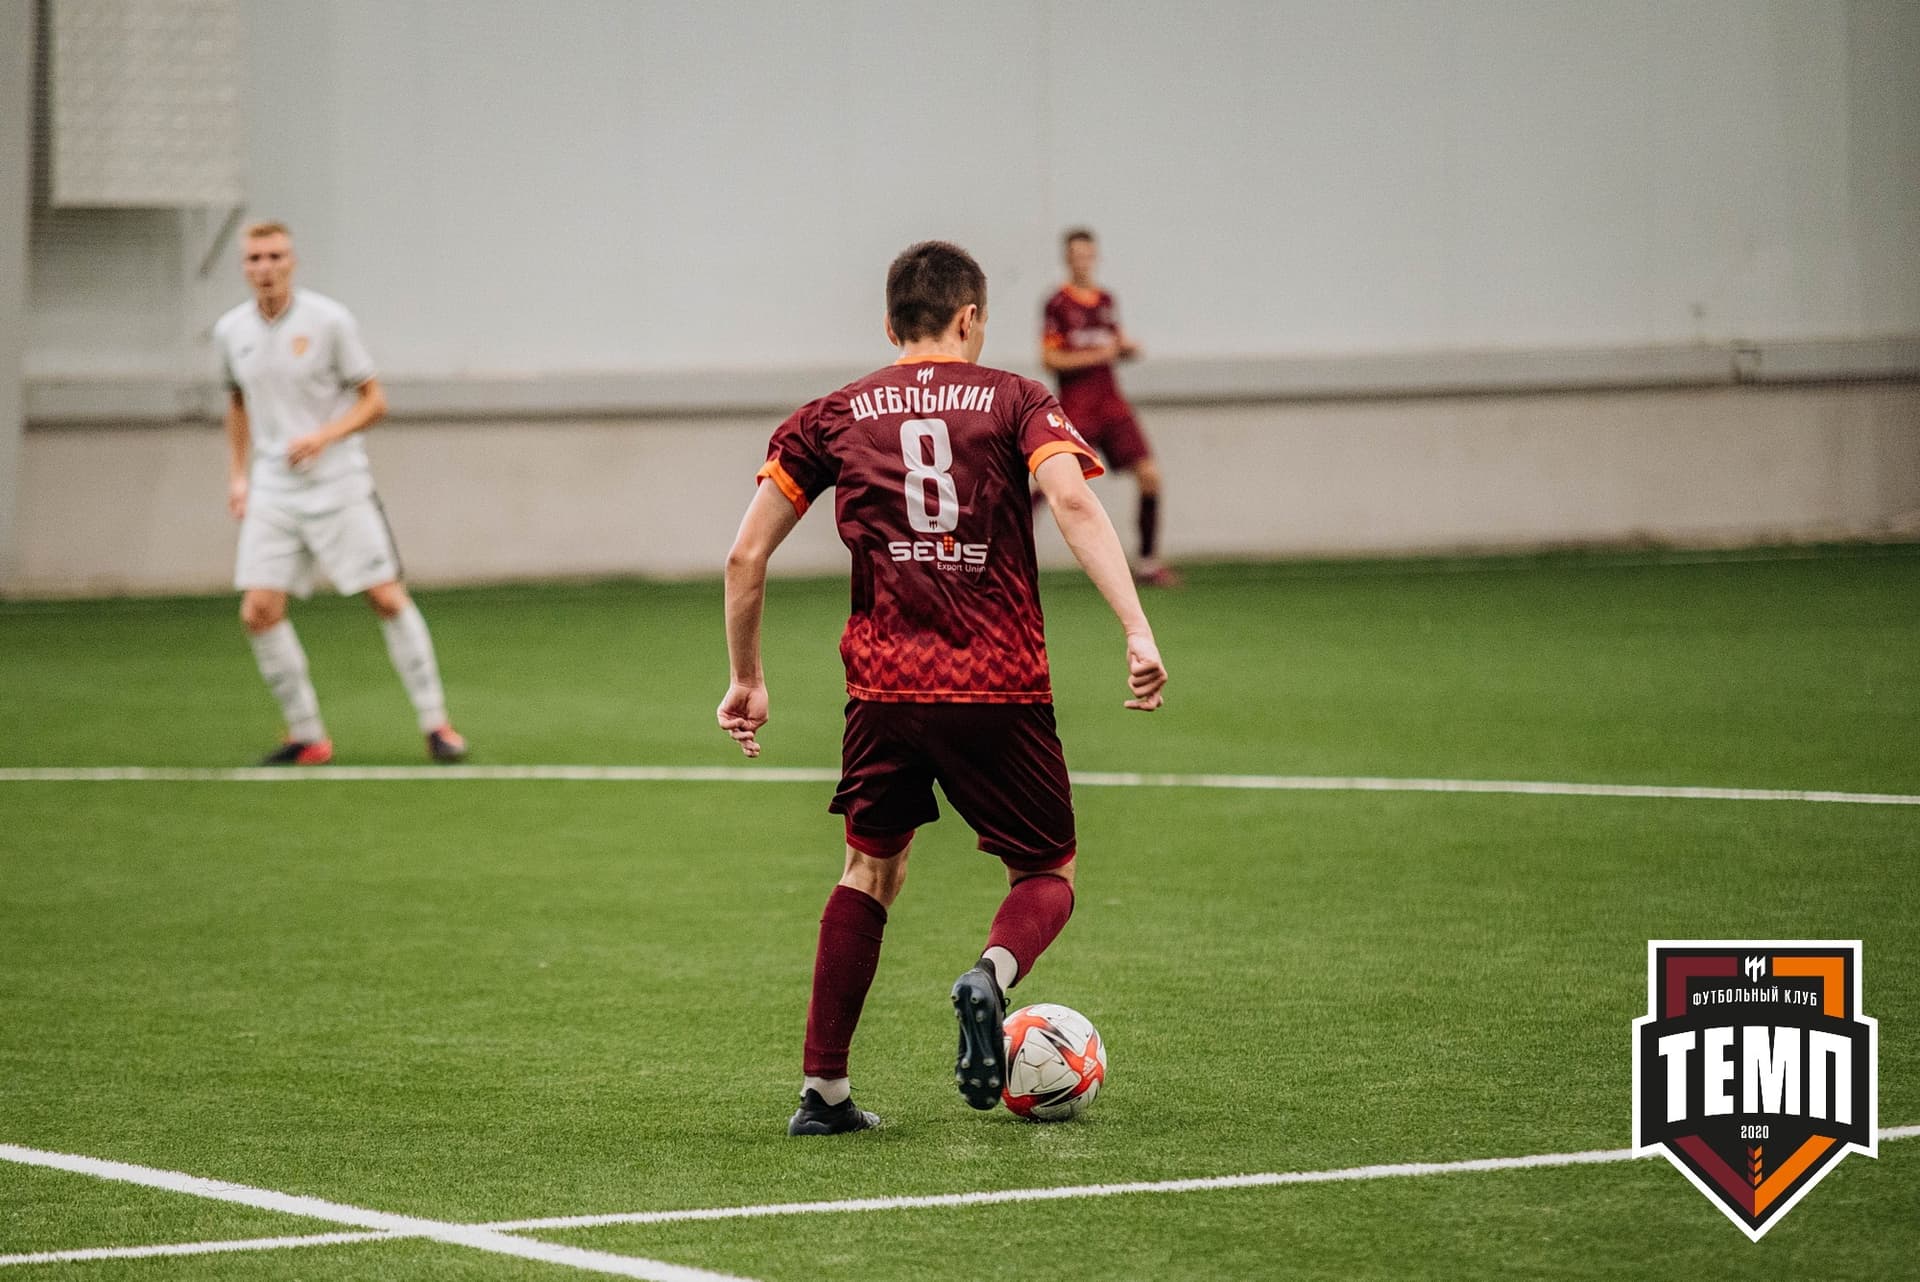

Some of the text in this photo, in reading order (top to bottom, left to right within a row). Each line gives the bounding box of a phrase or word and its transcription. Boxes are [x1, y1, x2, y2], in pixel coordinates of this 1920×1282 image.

[850, 384, 996, 422] ЩЕБЛЫКИН
[899, 418, 959, 533] 8
[887, 541, 989, 564] SEUS
[937, 562, 962, 573] Export
